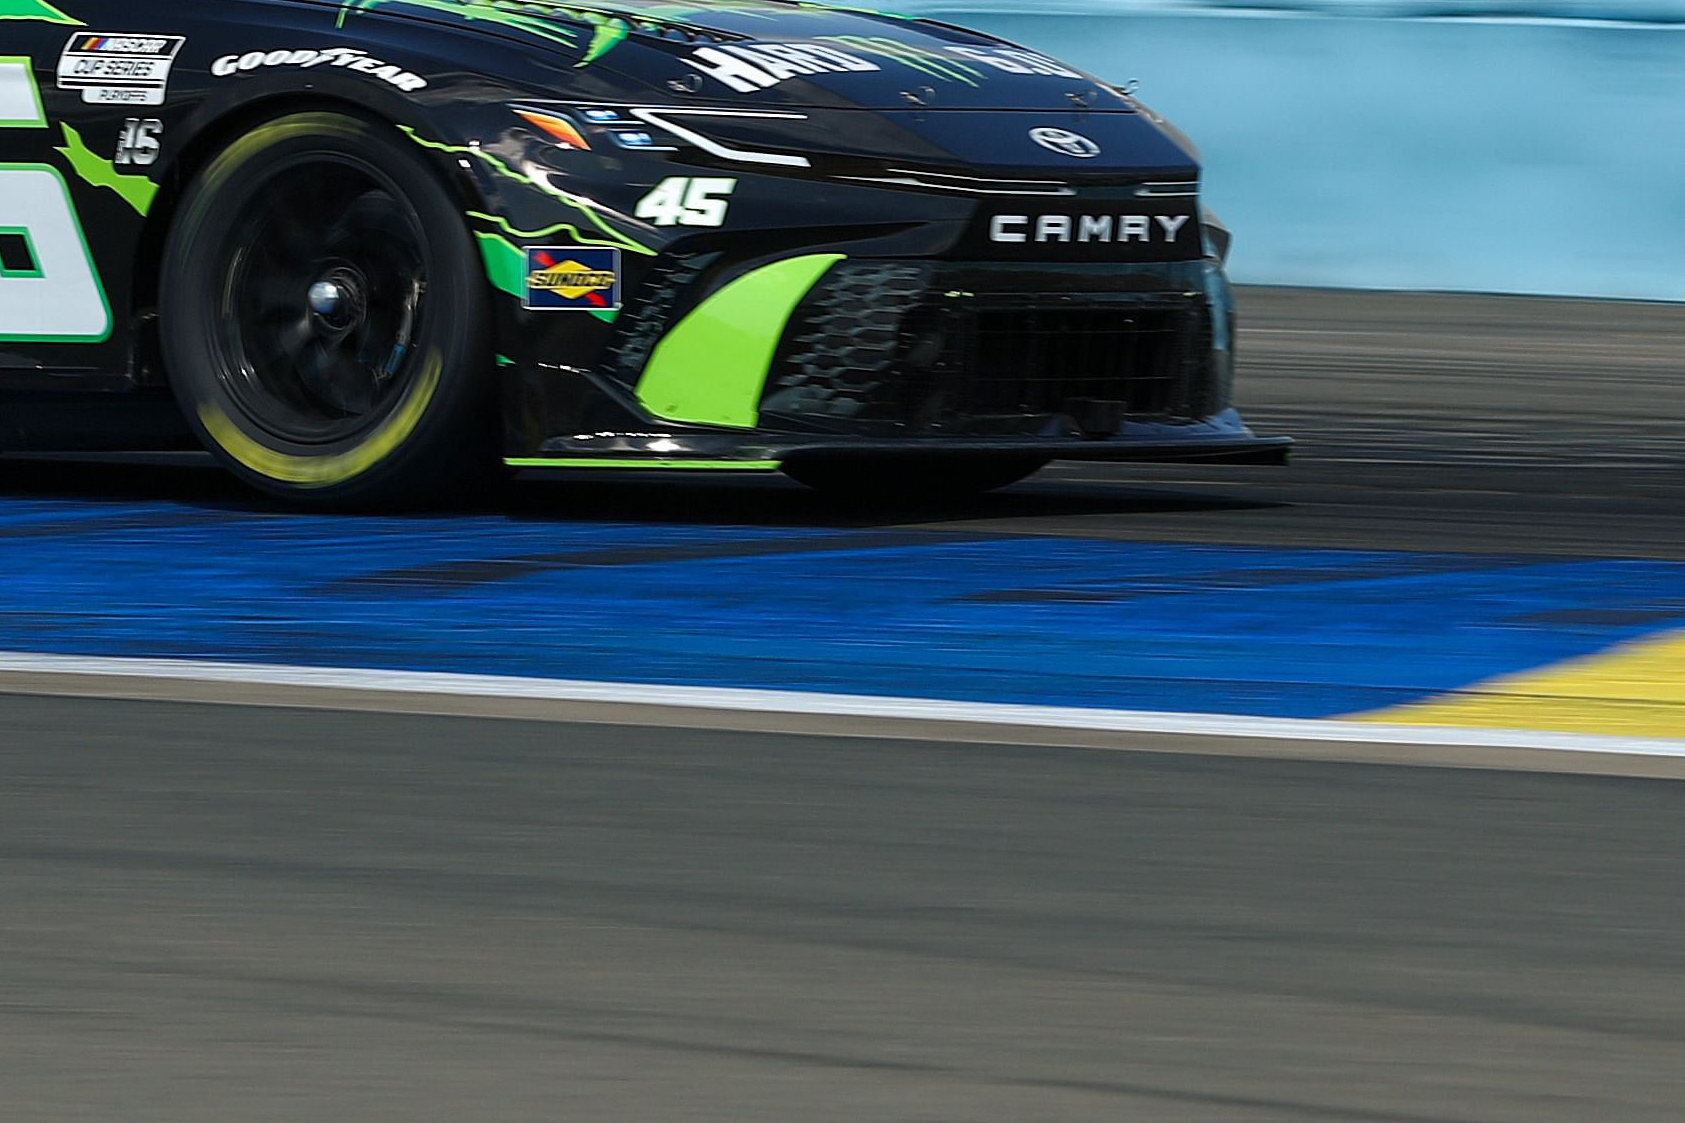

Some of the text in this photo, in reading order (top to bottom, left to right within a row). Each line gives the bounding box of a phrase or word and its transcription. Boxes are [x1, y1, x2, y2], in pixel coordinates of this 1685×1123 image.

[99, 37, 167, 54] NASCAR
[73, 59, 155, 76] CUP SERIES
[211, 47, 428, 92] GOODYEAR
[677, 43, 881, 93] HARD
[114, 118, 164, 165] 16
[634, 177, 738, 227] 45
[989, 214, 1191, 243] CAMRY
[526, 272, 617, 288] SUNOCO
